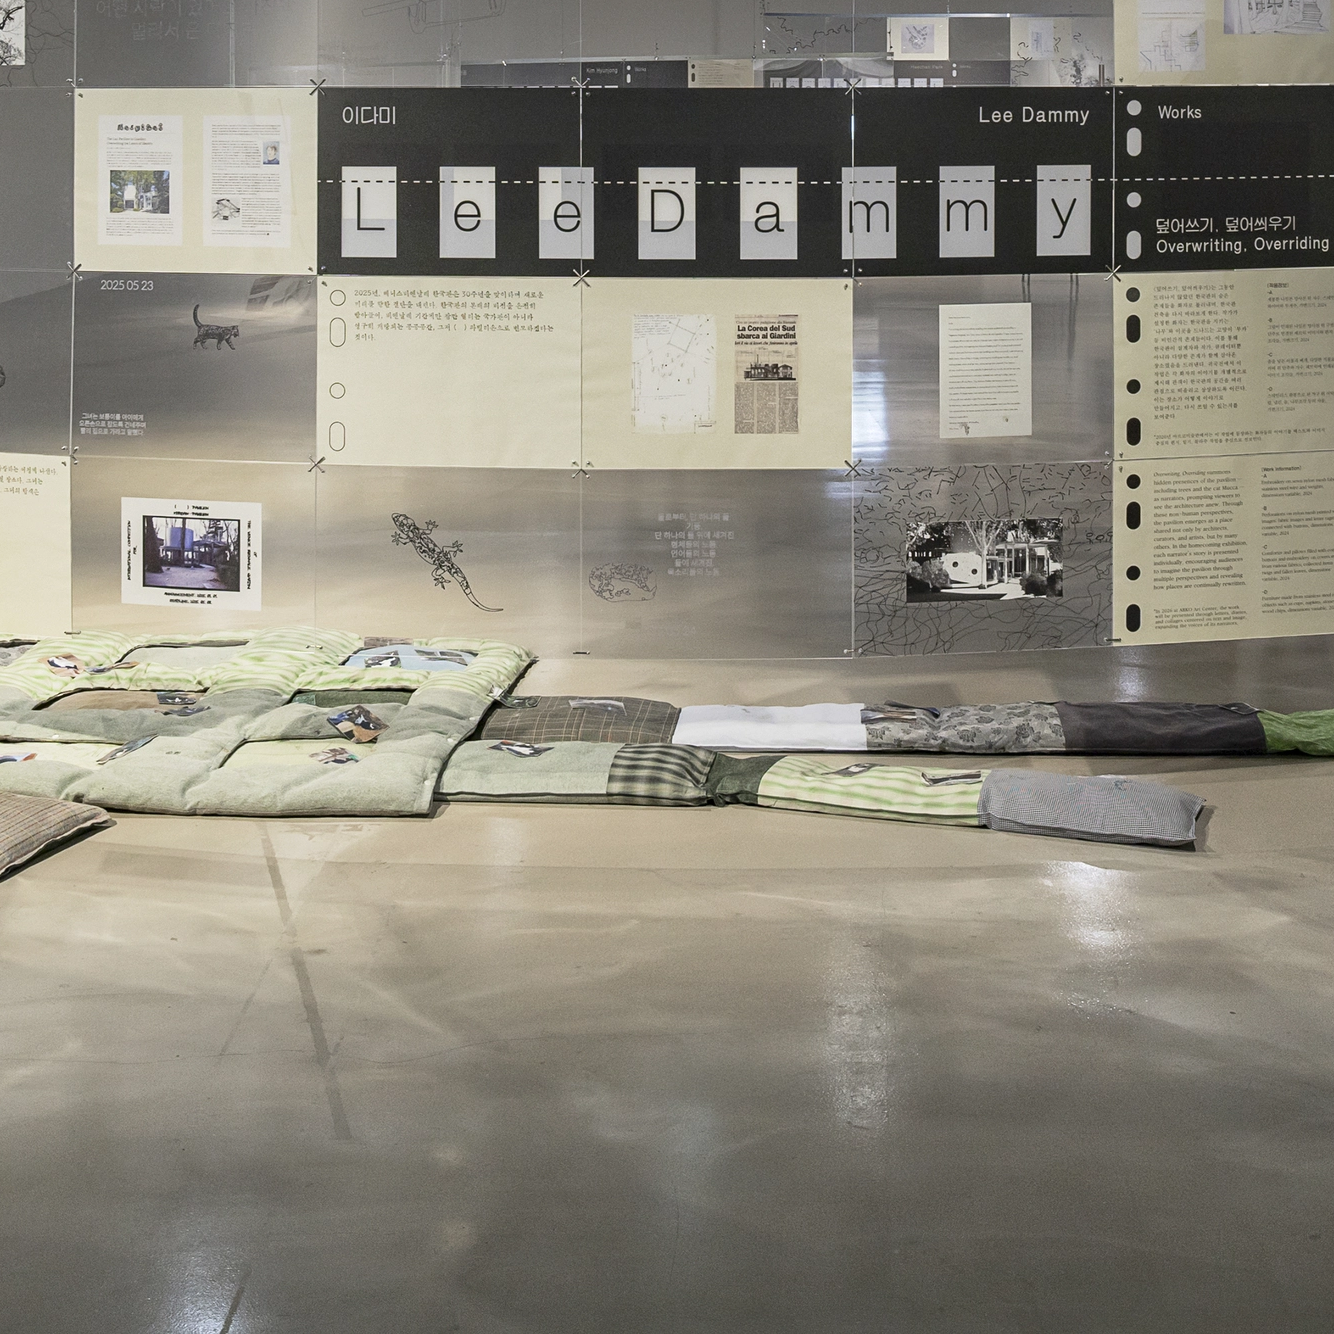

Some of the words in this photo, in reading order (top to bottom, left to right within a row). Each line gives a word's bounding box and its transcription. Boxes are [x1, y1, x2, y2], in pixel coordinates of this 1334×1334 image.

[343, 107, 395, 124] 이다미
[980, 107, 1012, 122] Lee
[1023, 107, 1089, 125] Dammy
[1158, 105, 1201, 118] Works
[1226, 216, 1295, 232] 덮어씌우기
[1157, 239, 1246, 254] Overwriting,
[1255, 236, 1328, 251] Overriding
[101, 280, 124, 291] 2025
[126, 280, 139, 291] 05
[141, 280, 154, 291] 23
